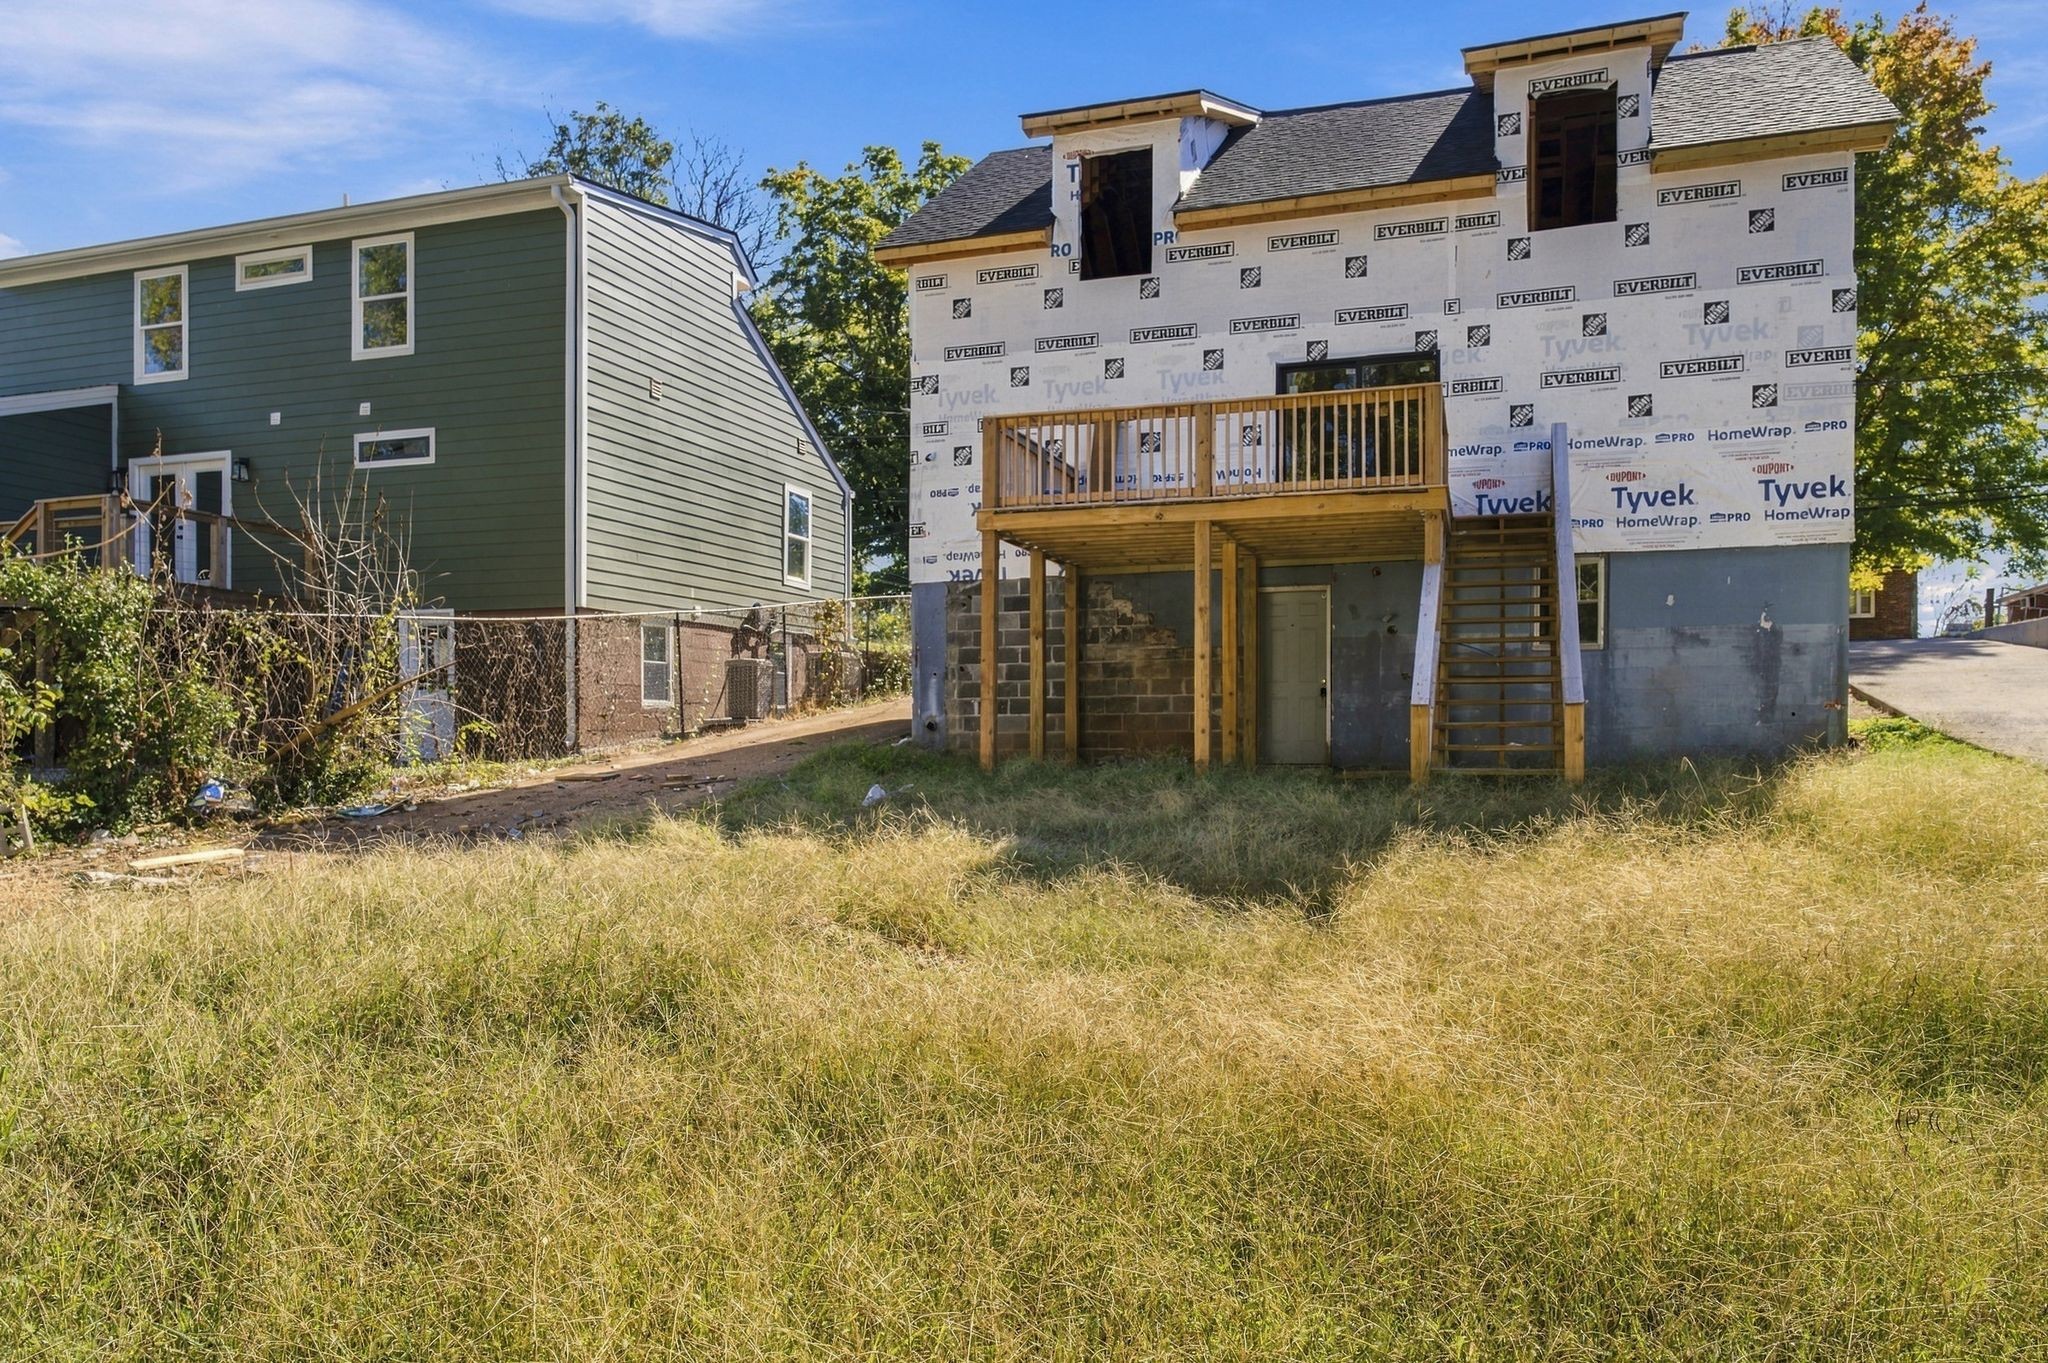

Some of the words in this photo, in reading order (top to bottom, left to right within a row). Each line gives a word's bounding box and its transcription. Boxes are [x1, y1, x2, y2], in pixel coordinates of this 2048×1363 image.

[1532, 71, 1606, 93] EVERBILT
[1660, 184, 1737, 203] EVERBILT
[1377, 220, 1445, 238] EVERBILT
[1270, 233, 1336, 249] EVERBILT
[1169, 244, 1231, 261] EVERBILT
[979, 267, 1036, 282] EVERBILT
[1740, 263, 1820, 281] EVERBILT
[1617, 276, 1693, 294] EVERBILT
[1500, 289, 1572, 306] EVERBILT
[1338, 307, 1405, 322] EVERBILT
[1233, 317, 1297, 332] EVERBILT
[1133, 326, 1194, 341] EVERBILT
[1682, 317, 1770, 349] Tyvek
[1038, 336, 1096, 350] EVERBILT
[947, 345, 1002, 359] EVERBILT
[1663, 358, 1741, 376] EVERBILT
[1543, 369, 1617, 386] EVERBILT
[1823, 420, 1847, 431] PRO
[1672, 433, 1695, 442] PRO
[1708, 426, 1792, 441] HomeWrap
[1530, 441, 1551, 451] PRO
[1757, 463, 1790, 474] DUPONT
[1610, 471, 1642, 482] DUPONT
[1611, 483, 1695, 514] Tyvek
[1758, 475, 1846, 507] Tyvek
[1616, 515, 1698, 528] HomeWrap
[1727, 512, 1751, 522] PRO
[1764, 507, 1850, 522] HomeWrap
[1582, 519, 1604, 528] PRO
